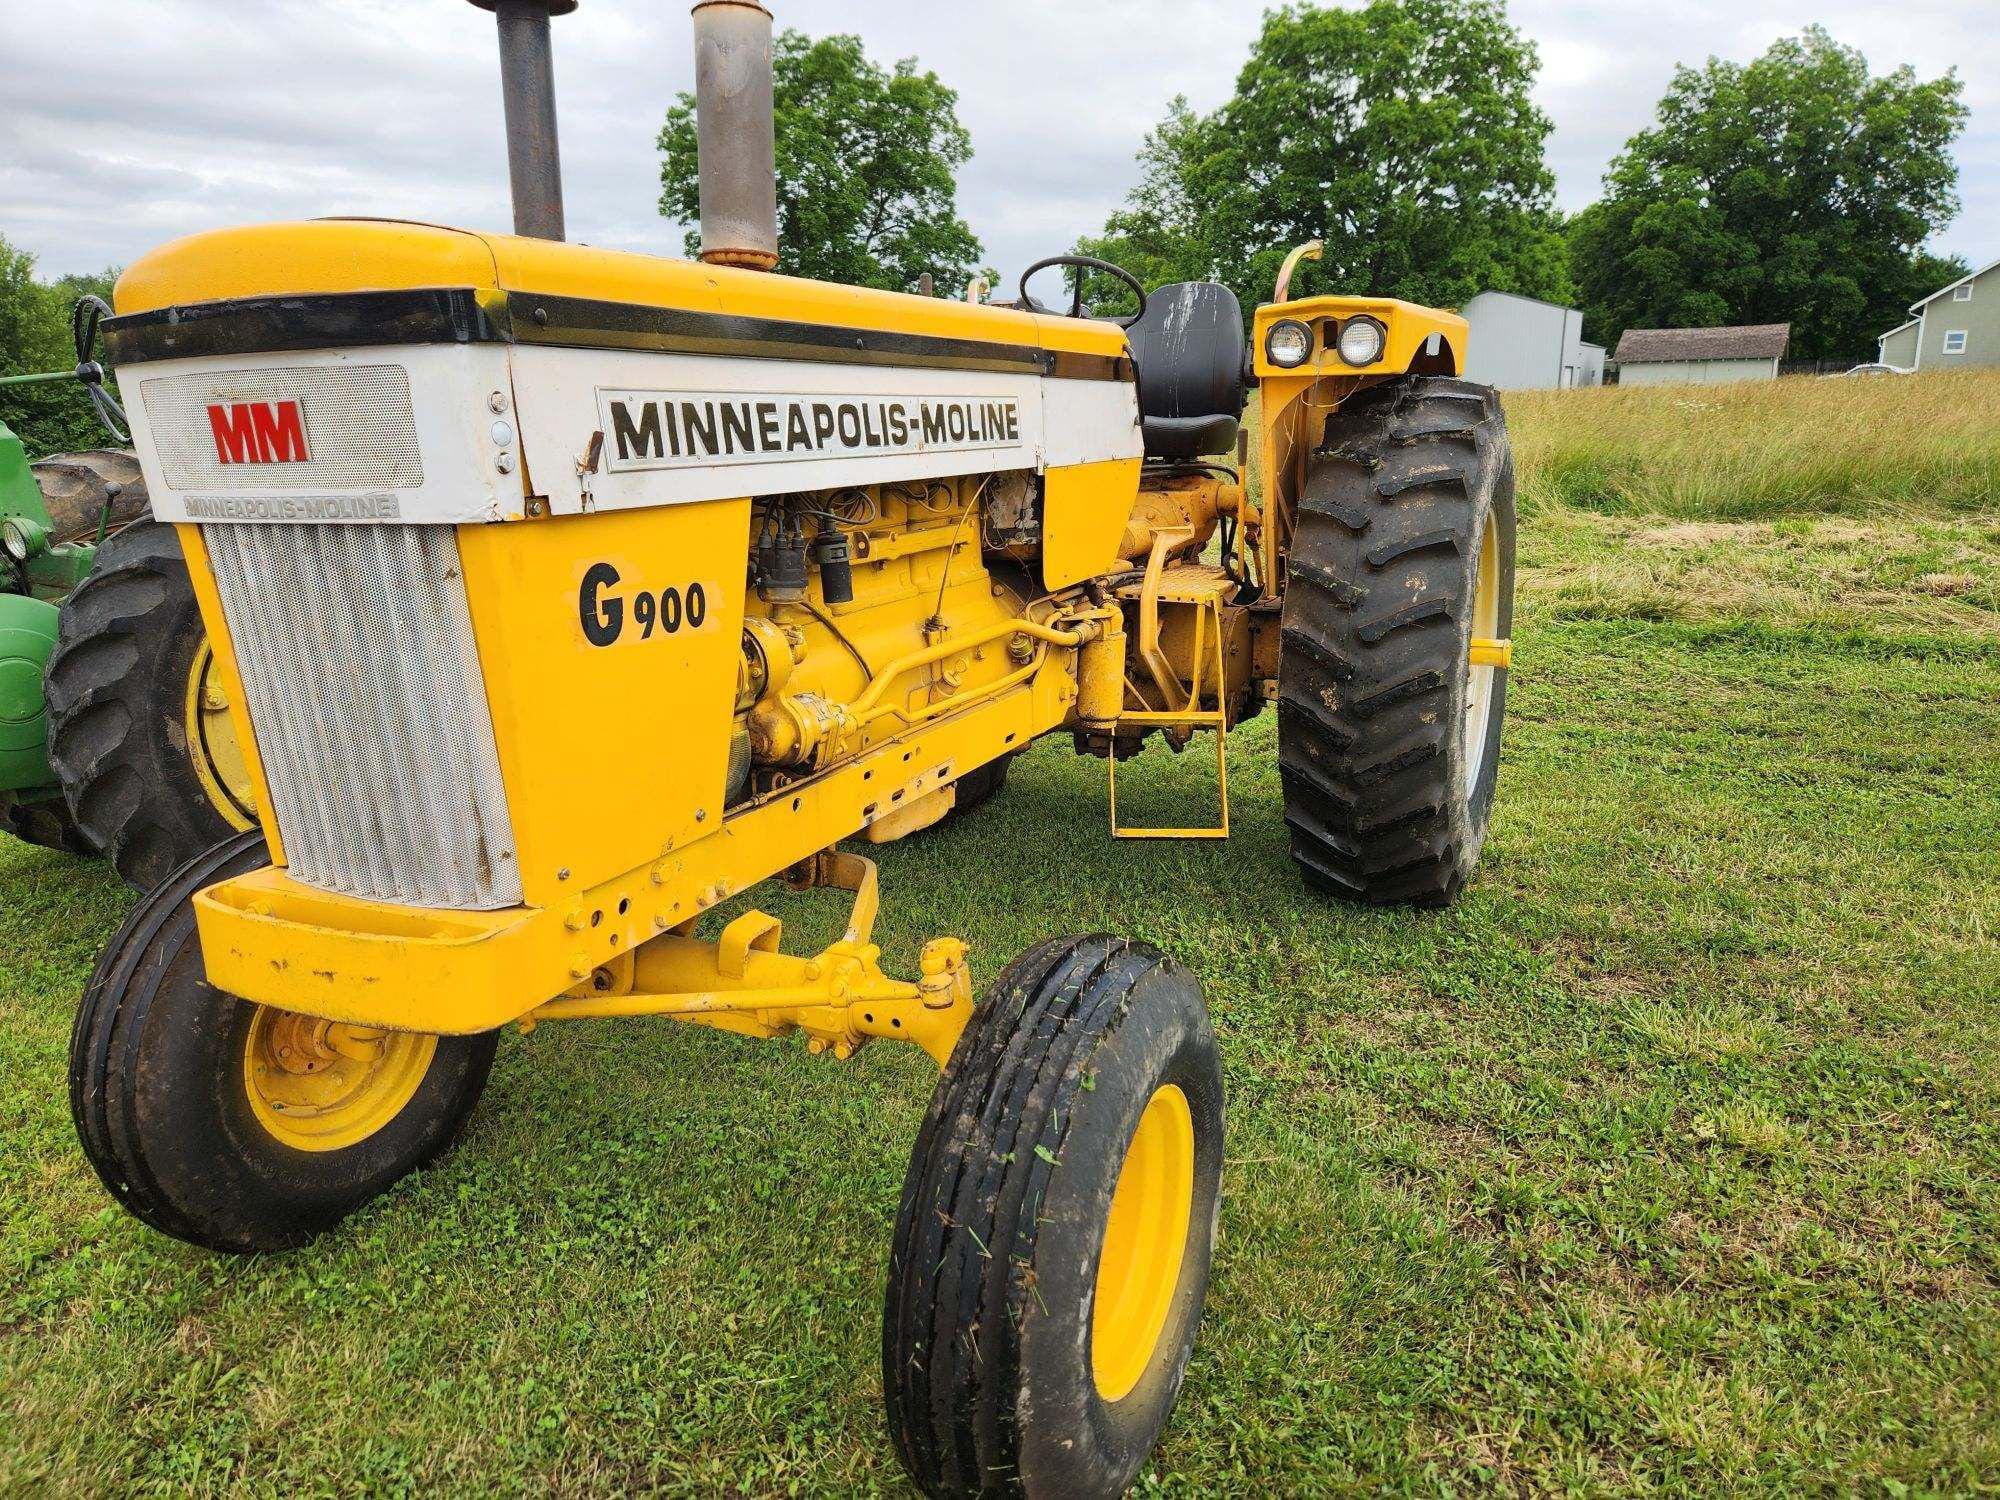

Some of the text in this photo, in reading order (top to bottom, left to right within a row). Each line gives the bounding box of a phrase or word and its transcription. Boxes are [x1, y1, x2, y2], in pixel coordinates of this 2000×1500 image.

[207, 400, 309, 464] MM
[611, 401, 1019, 460] MINNEAPOLIS-MOLINE
[185, 496, 394, 519] MINNEAPOLIS-MOLINE
[579, 562, 706, 648] G 900
